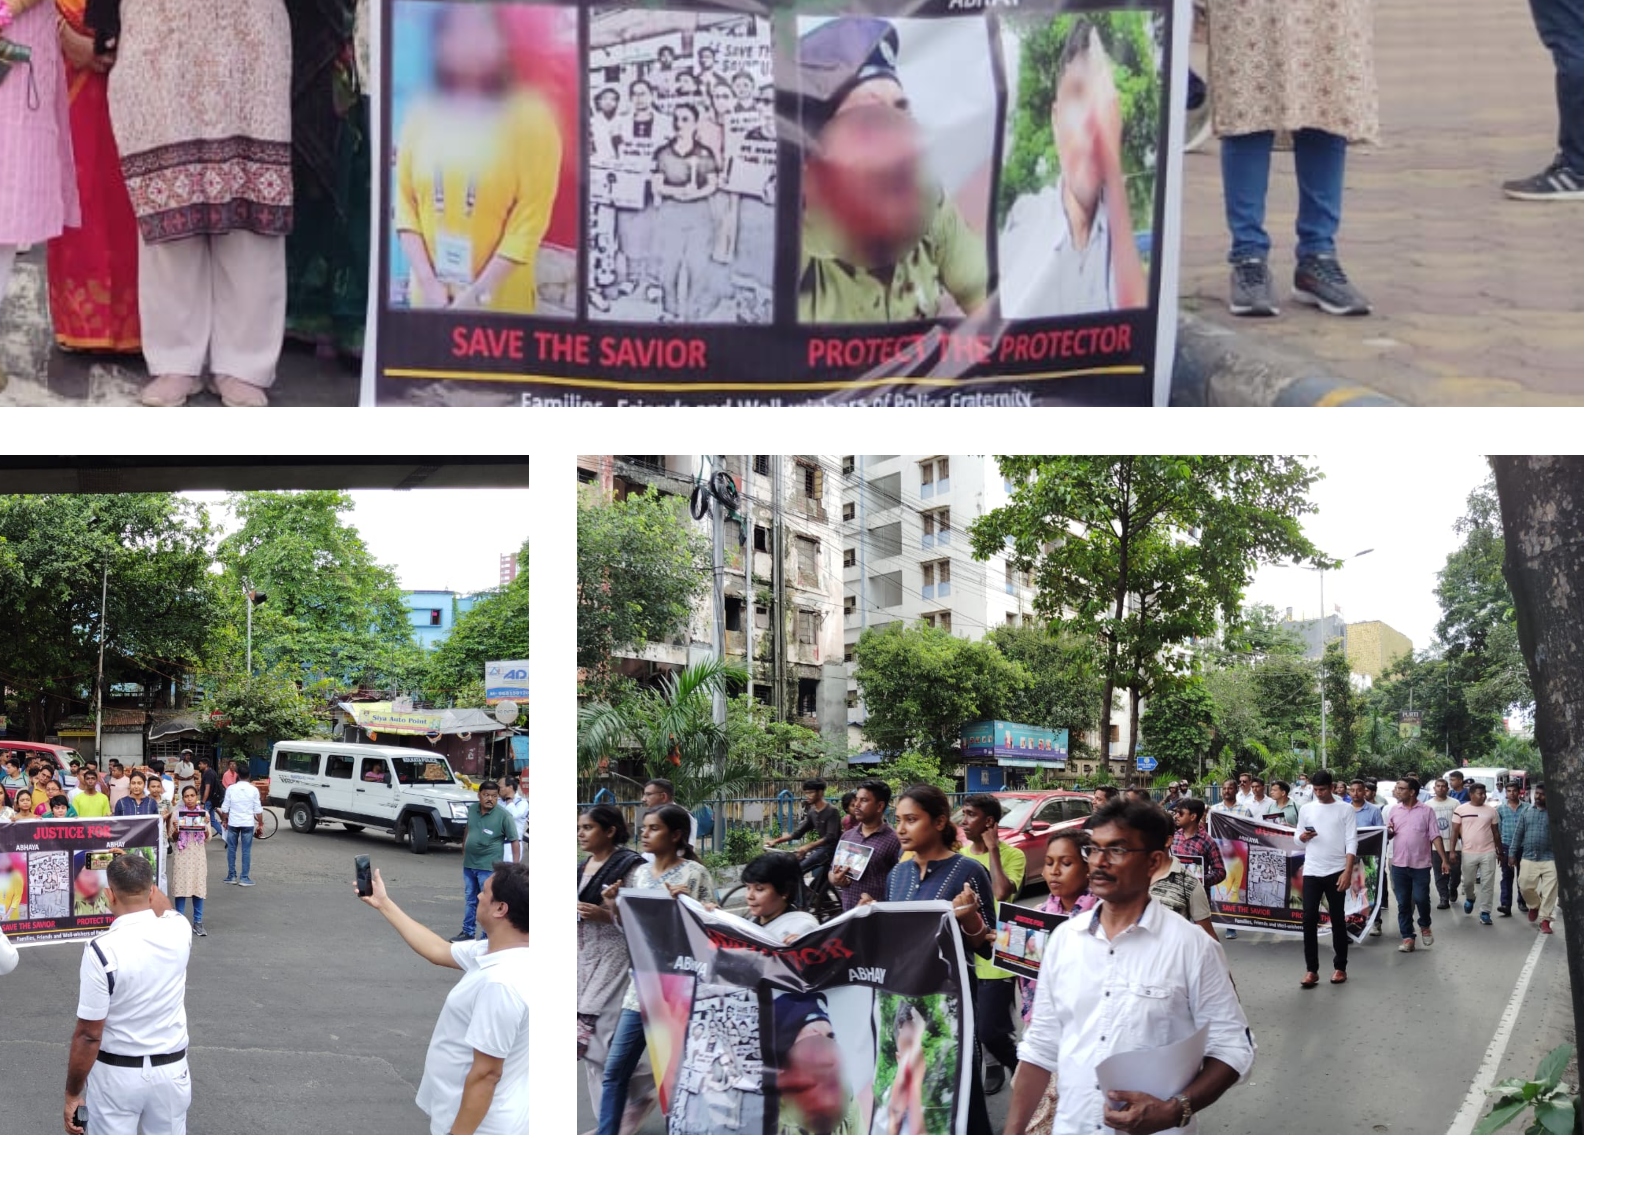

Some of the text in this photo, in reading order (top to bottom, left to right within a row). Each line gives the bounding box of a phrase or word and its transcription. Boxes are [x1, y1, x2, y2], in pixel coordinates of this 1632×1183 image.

[452, 327, 706, 368] SAVE THE SAVIOR
[808, 324, 1131, 367] PROTECT THE PROTECTOR
[33, 825, 112, 839] JUSTICE FOR
[15, 844, 40, 852] ABHAYA
[1250, 907, 1271, 916] SAVIOR
[1, 920, 55, 931] SAVE THE SAVIOR
[77, 917, 104, 926] PROTECT
[849, 967, 886, 984] ABHAY
